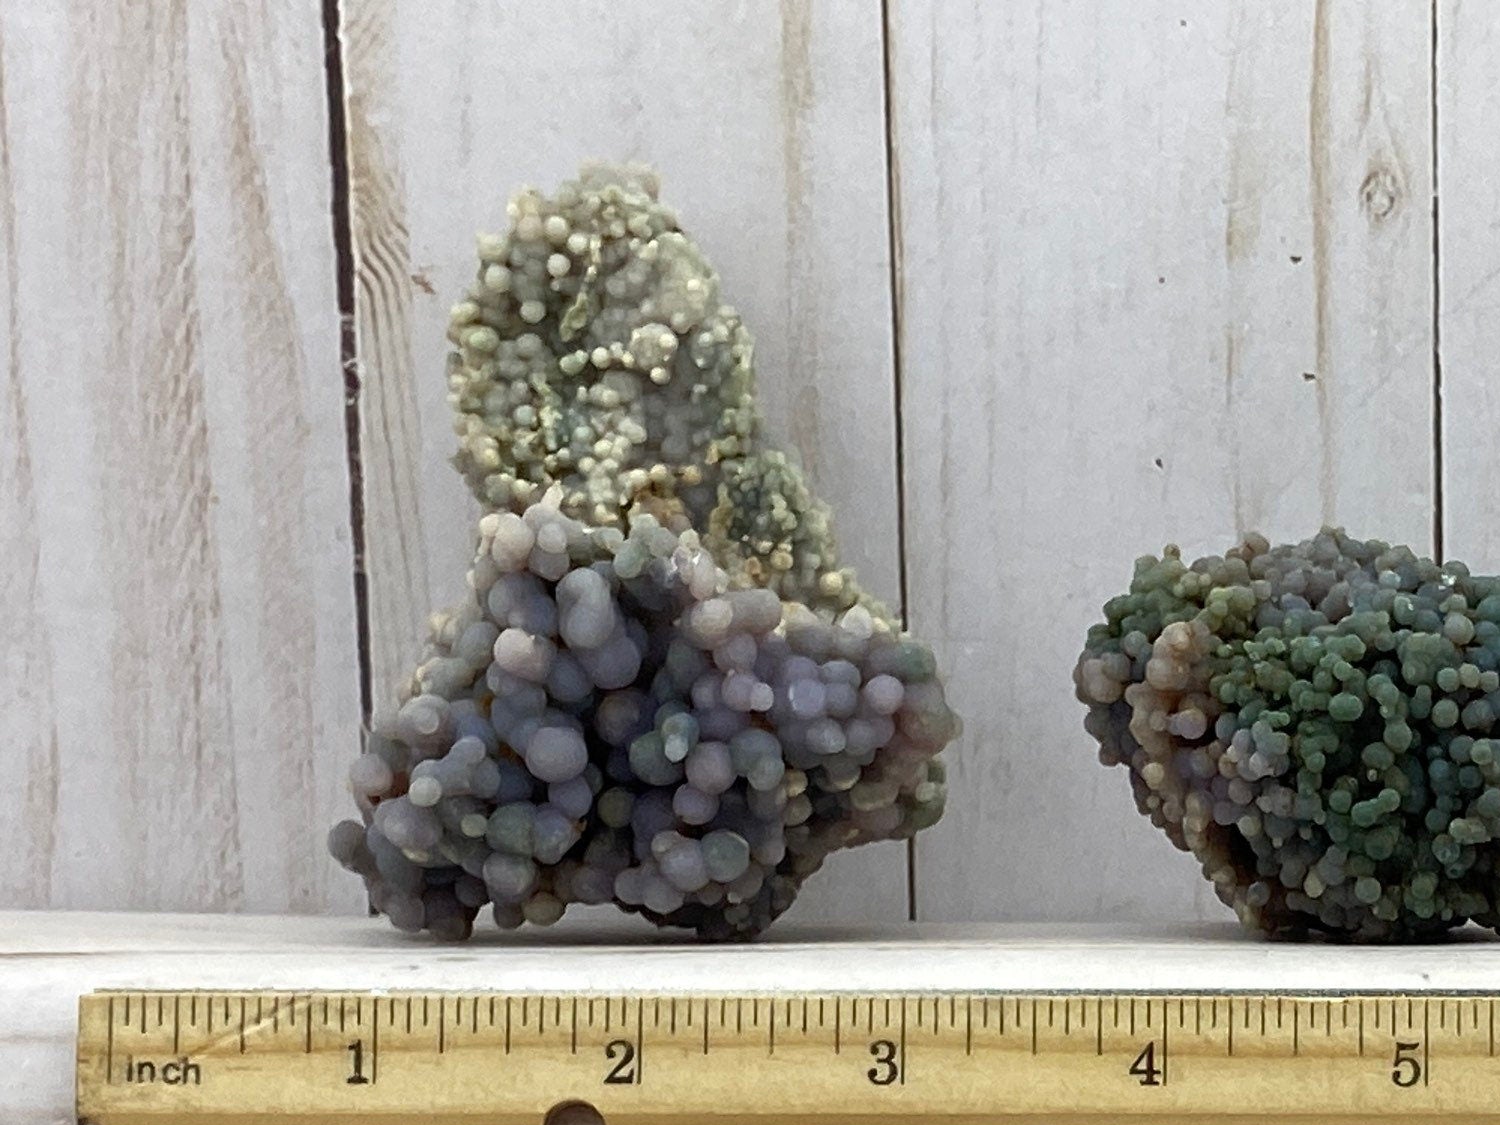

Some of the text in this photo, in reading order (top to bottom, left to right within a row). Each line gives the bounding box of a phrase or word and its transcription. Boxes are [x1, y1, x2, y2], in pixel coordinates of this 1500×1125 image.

[126, 1056, 200, 1086] inch
[346, 1040, 367, 1085] 1
[603, 1040, 636, 1084] 2
[868, 1041, 898, 1085] 3
[1129, 1042, 1162, 1086] 4
[1391, 1042, 1421, 1087] 5
